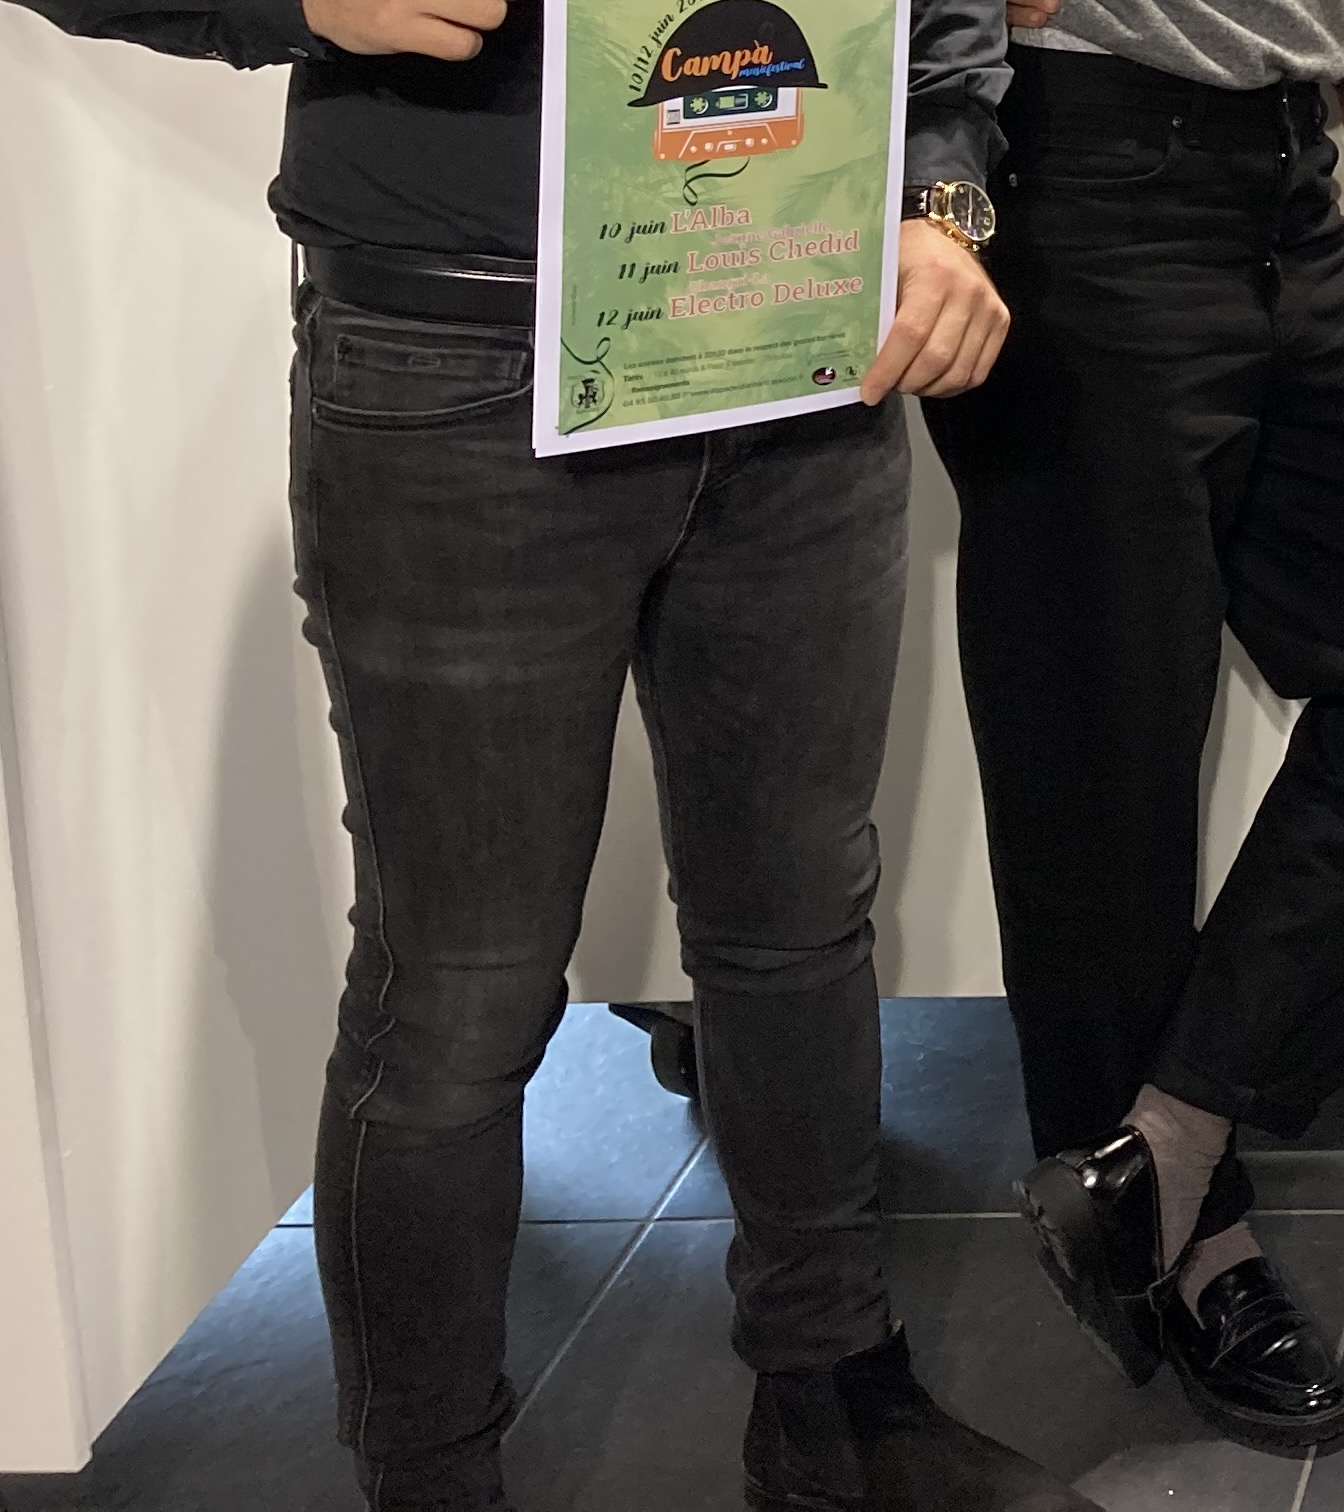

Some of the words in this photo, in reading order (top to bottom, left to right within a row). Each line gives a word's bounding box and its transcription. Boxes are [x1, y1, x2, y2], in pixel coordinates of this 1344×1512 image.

[648, 13, 675, 47] juin
[662, 39, 773, 82] Campà
[599, 222, 622, 240] 10
[624, 219, 668, 244] juin
[618, 262, 636, 280] 11
[638, 260, 681, 285] juin
[687, 244, 761, 274] Louis
[768, 228, 860, 262] Chedid
[597, 308, 619, 328] 12
[621, 306, 665, 330] juin
[668, 291, 764, 320] Electro
[773, 277, 864, 305] Deluxe
